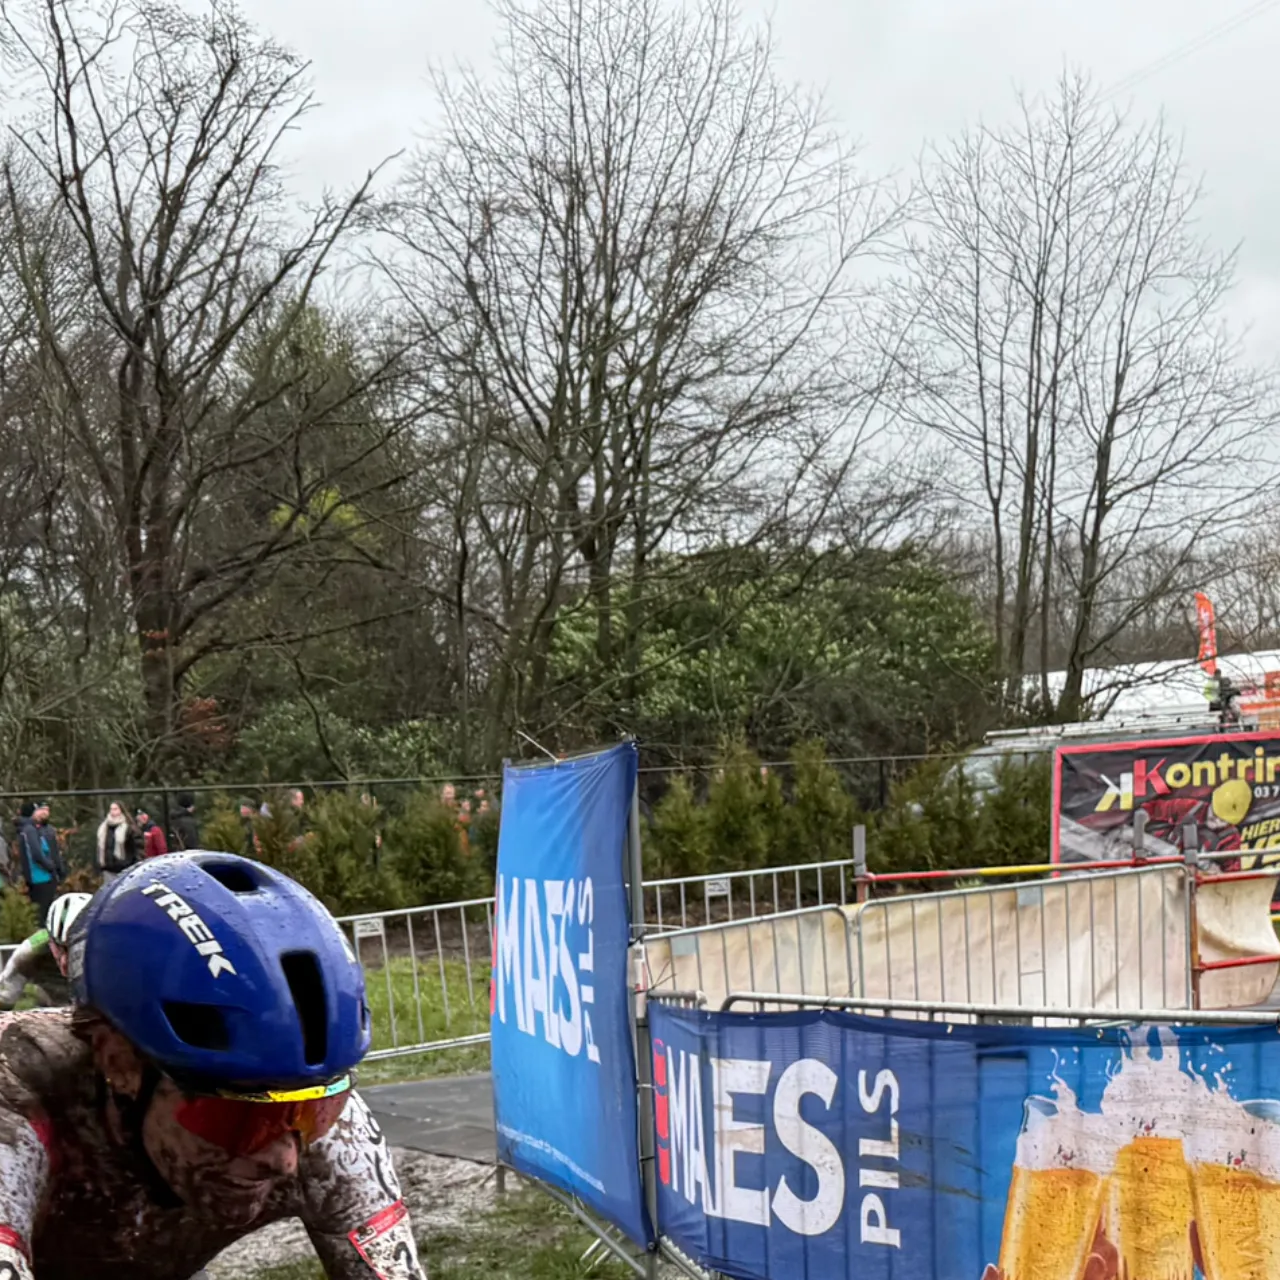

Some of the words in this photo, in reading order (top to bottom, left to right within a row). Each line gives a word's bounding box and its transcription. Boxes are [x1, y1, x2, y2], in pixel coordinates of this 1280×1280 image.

[1254, 786, 1270, 798] 03
[141, 878, 237, 979] TREK
[497, 873, 582, 1057] MAES
[577, 876, 601, 1065] PILS
[667, 1046, 846, 1236] MAES
[857, 1068, 902, 1249] PILS
